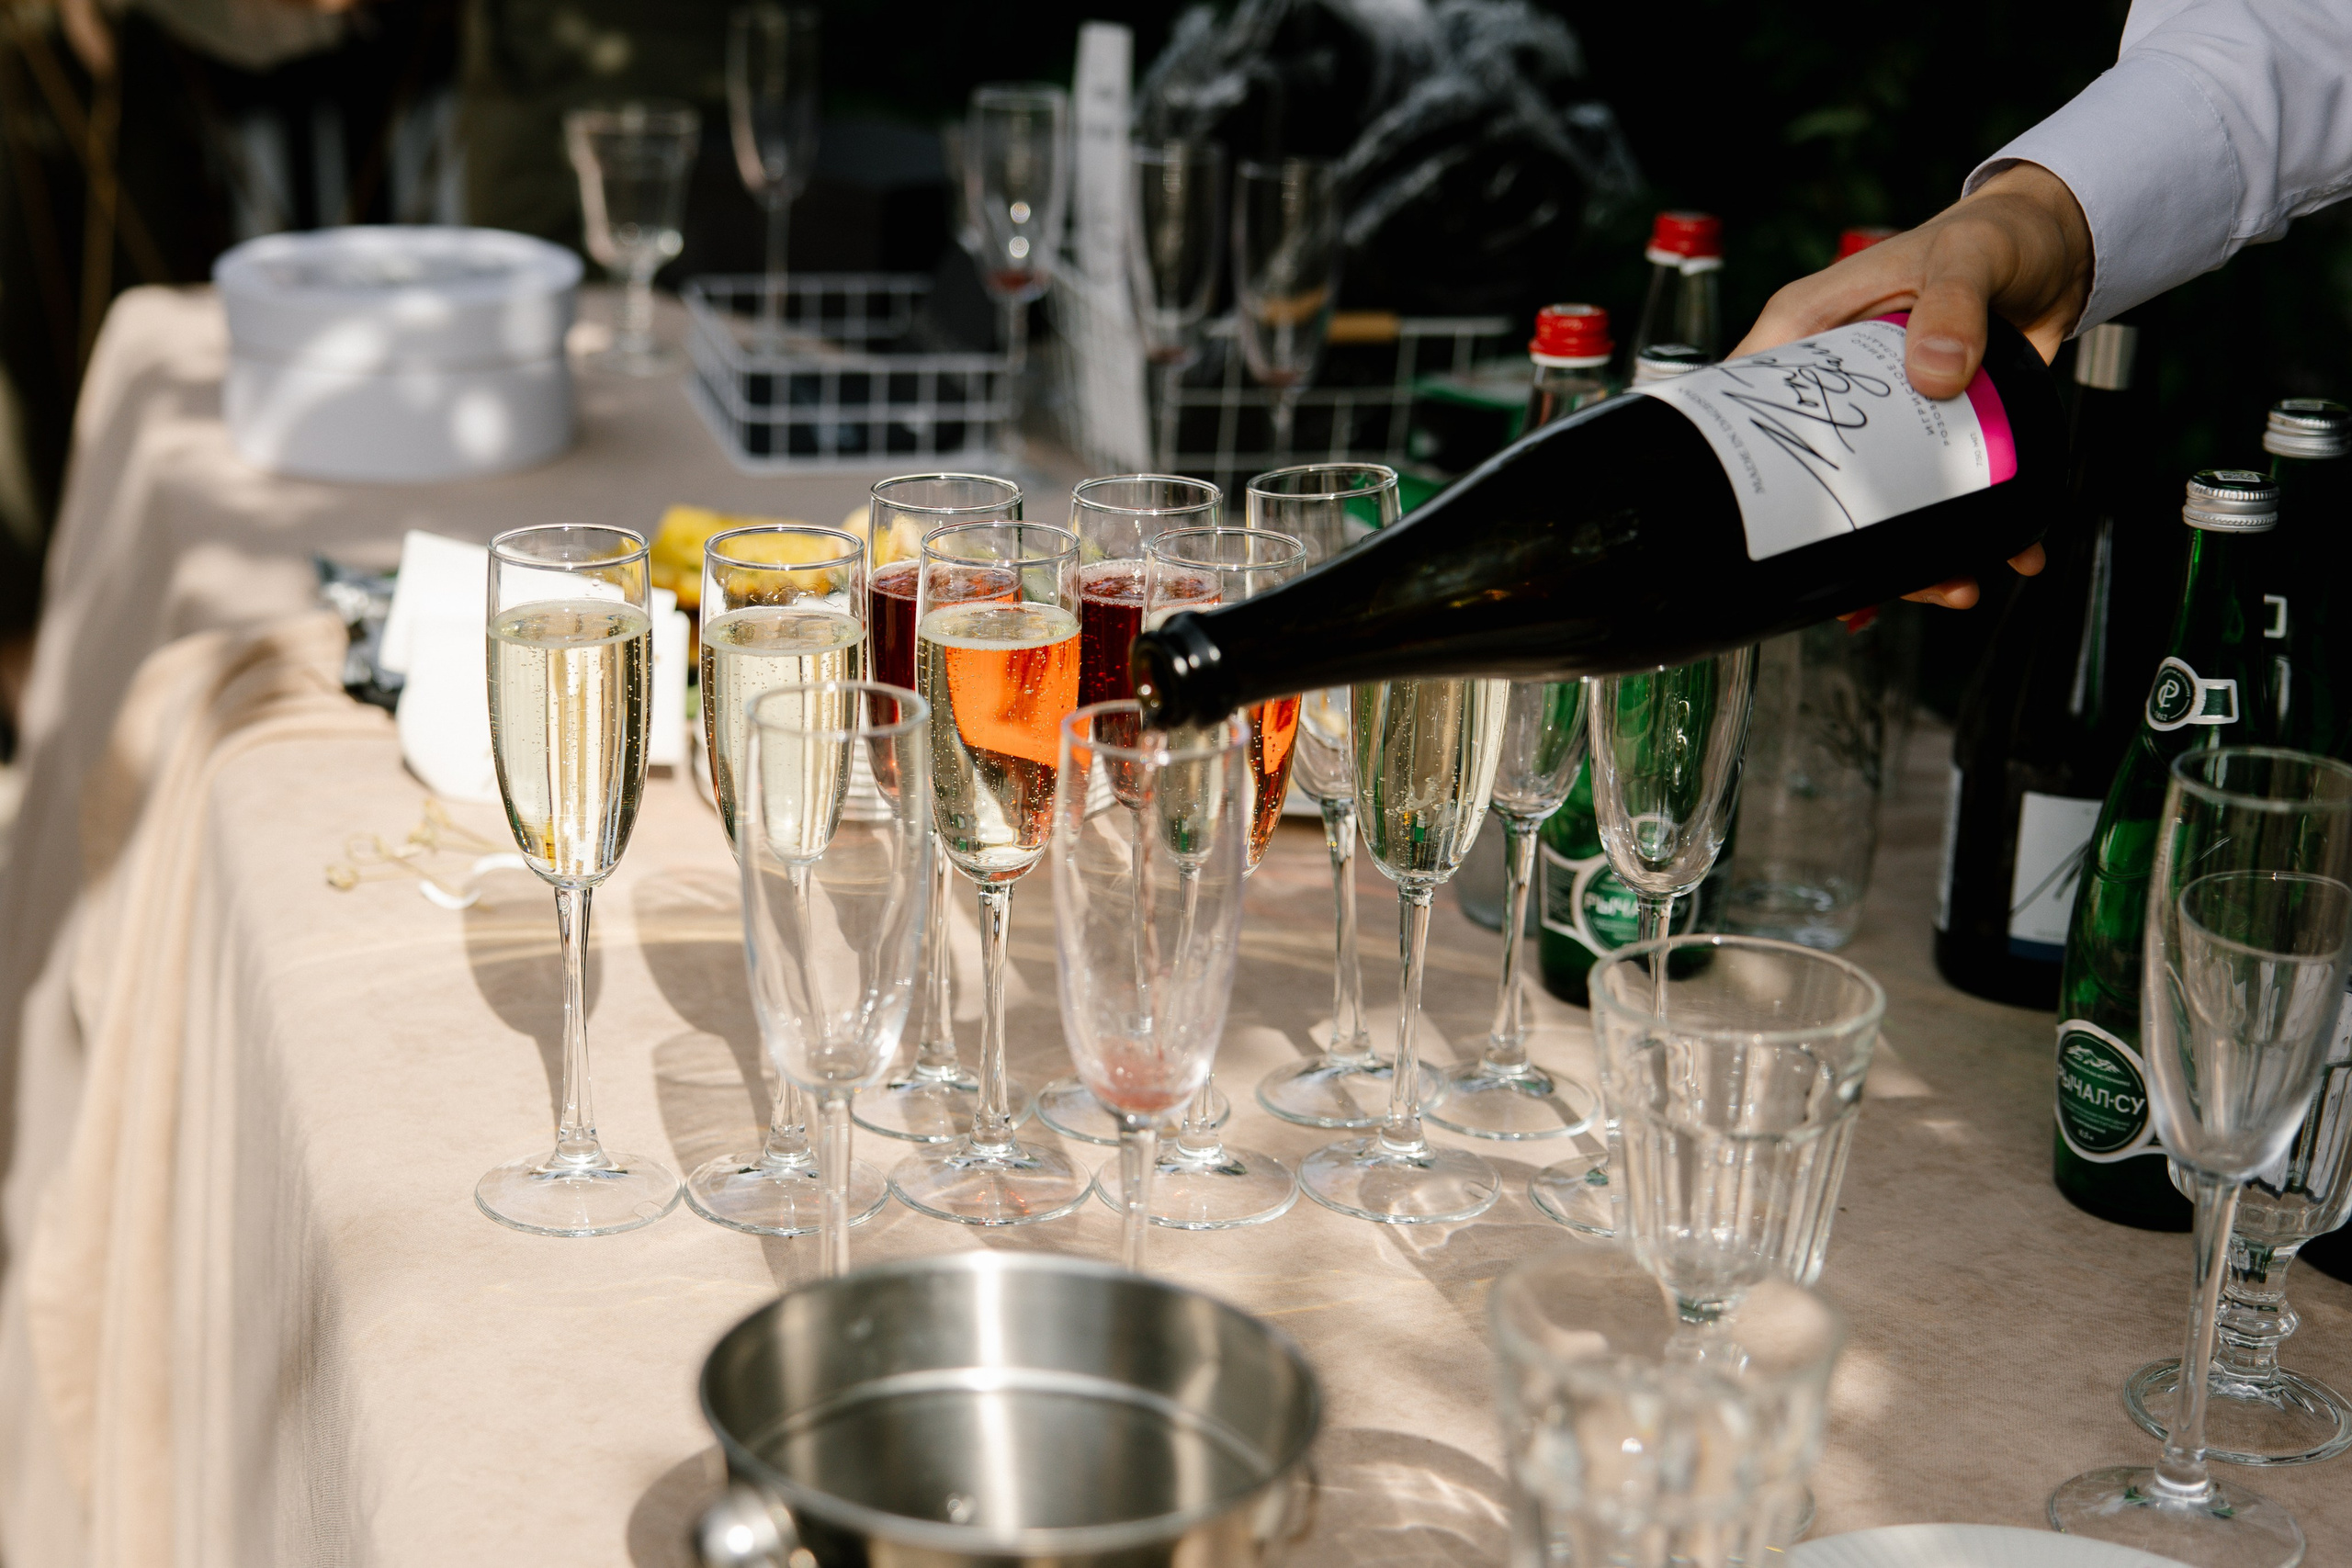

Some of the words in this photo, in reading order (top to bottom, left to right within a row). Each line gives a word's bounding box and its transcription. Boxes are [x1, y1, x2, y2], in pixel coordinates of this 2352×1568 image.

[1851, 338, 1885, 360] ВИНО
[1886, 364, 1935, 435] ИГРИСТОЕ
[1739, 449, 1765, 494] MADE
